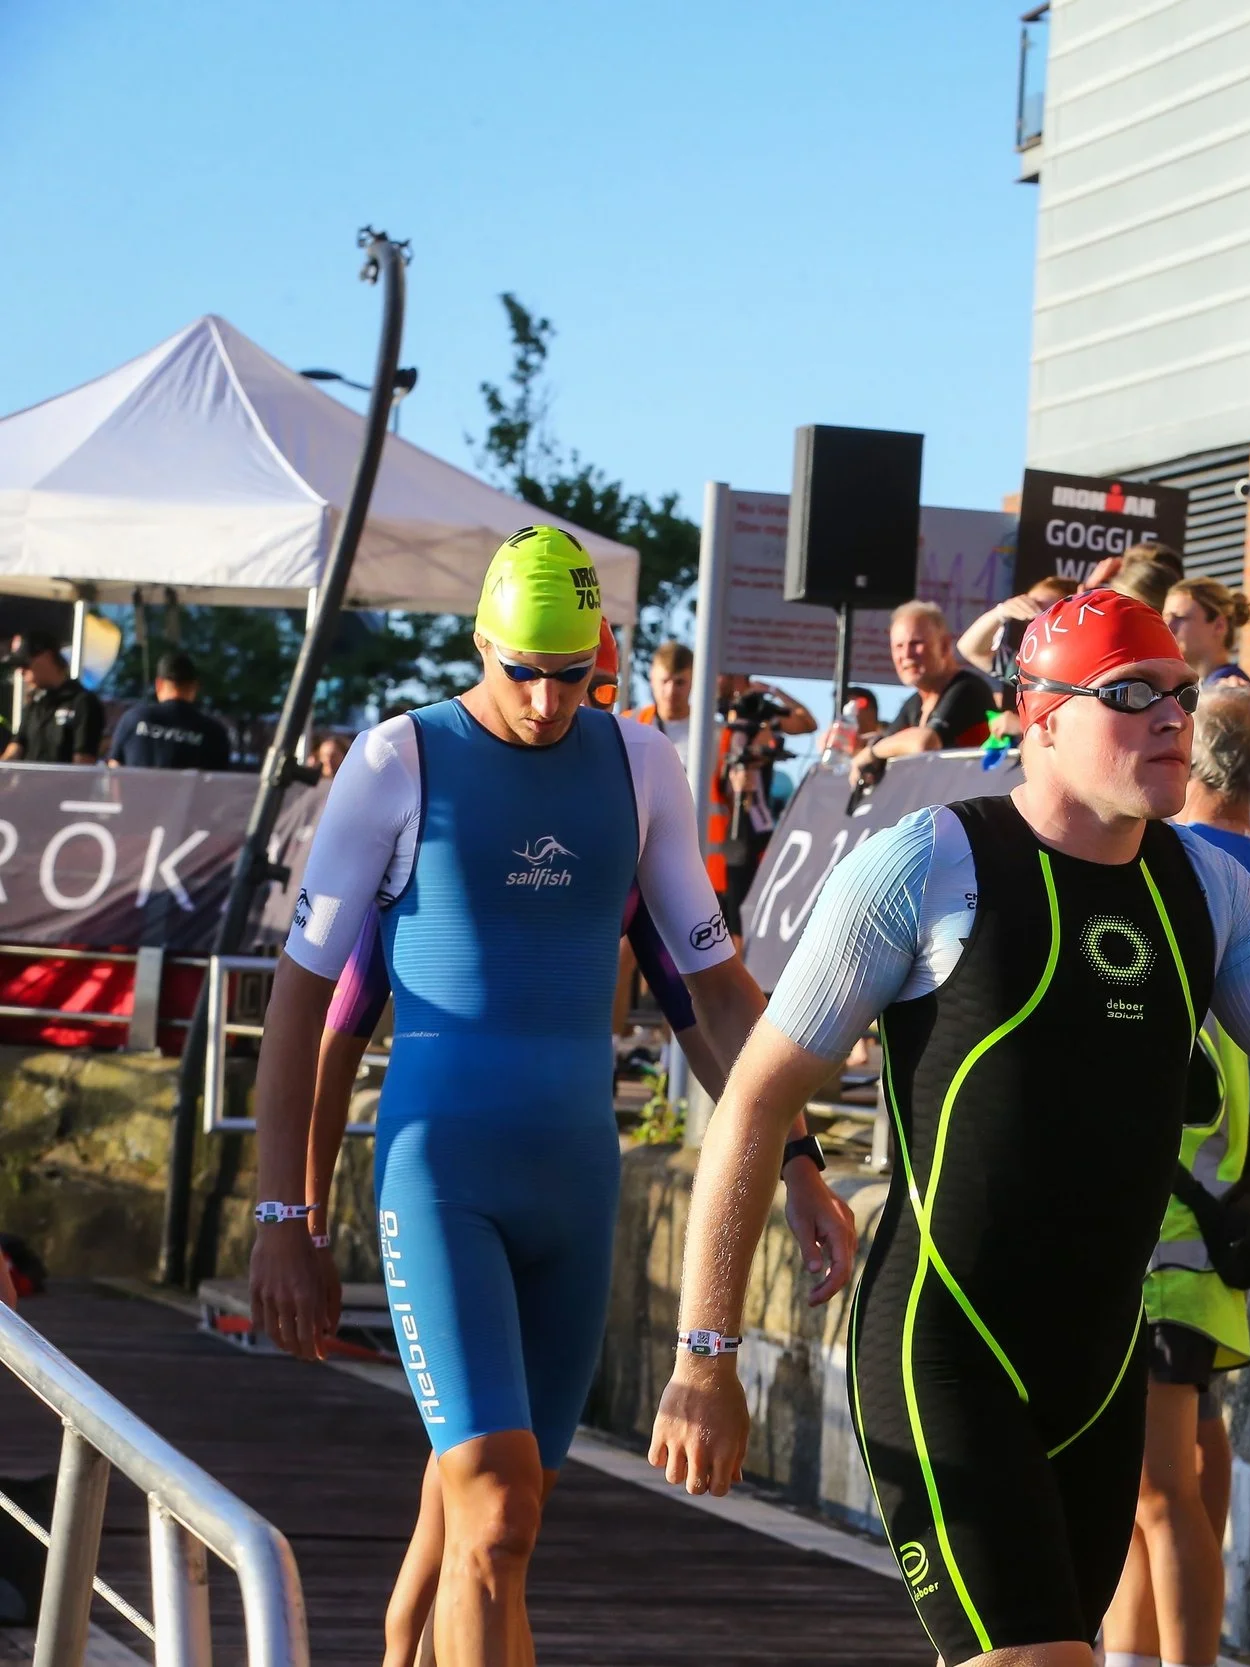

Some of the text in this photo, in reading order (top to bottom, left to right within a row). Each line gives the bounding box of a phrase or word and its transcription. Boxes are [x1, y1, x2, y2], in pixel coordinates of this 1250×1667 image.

[506, 868, 572, 891] sailfish
[1106, 998, 1144, 1011] deboer
[393, 1303, 446, 1424] Rebel
